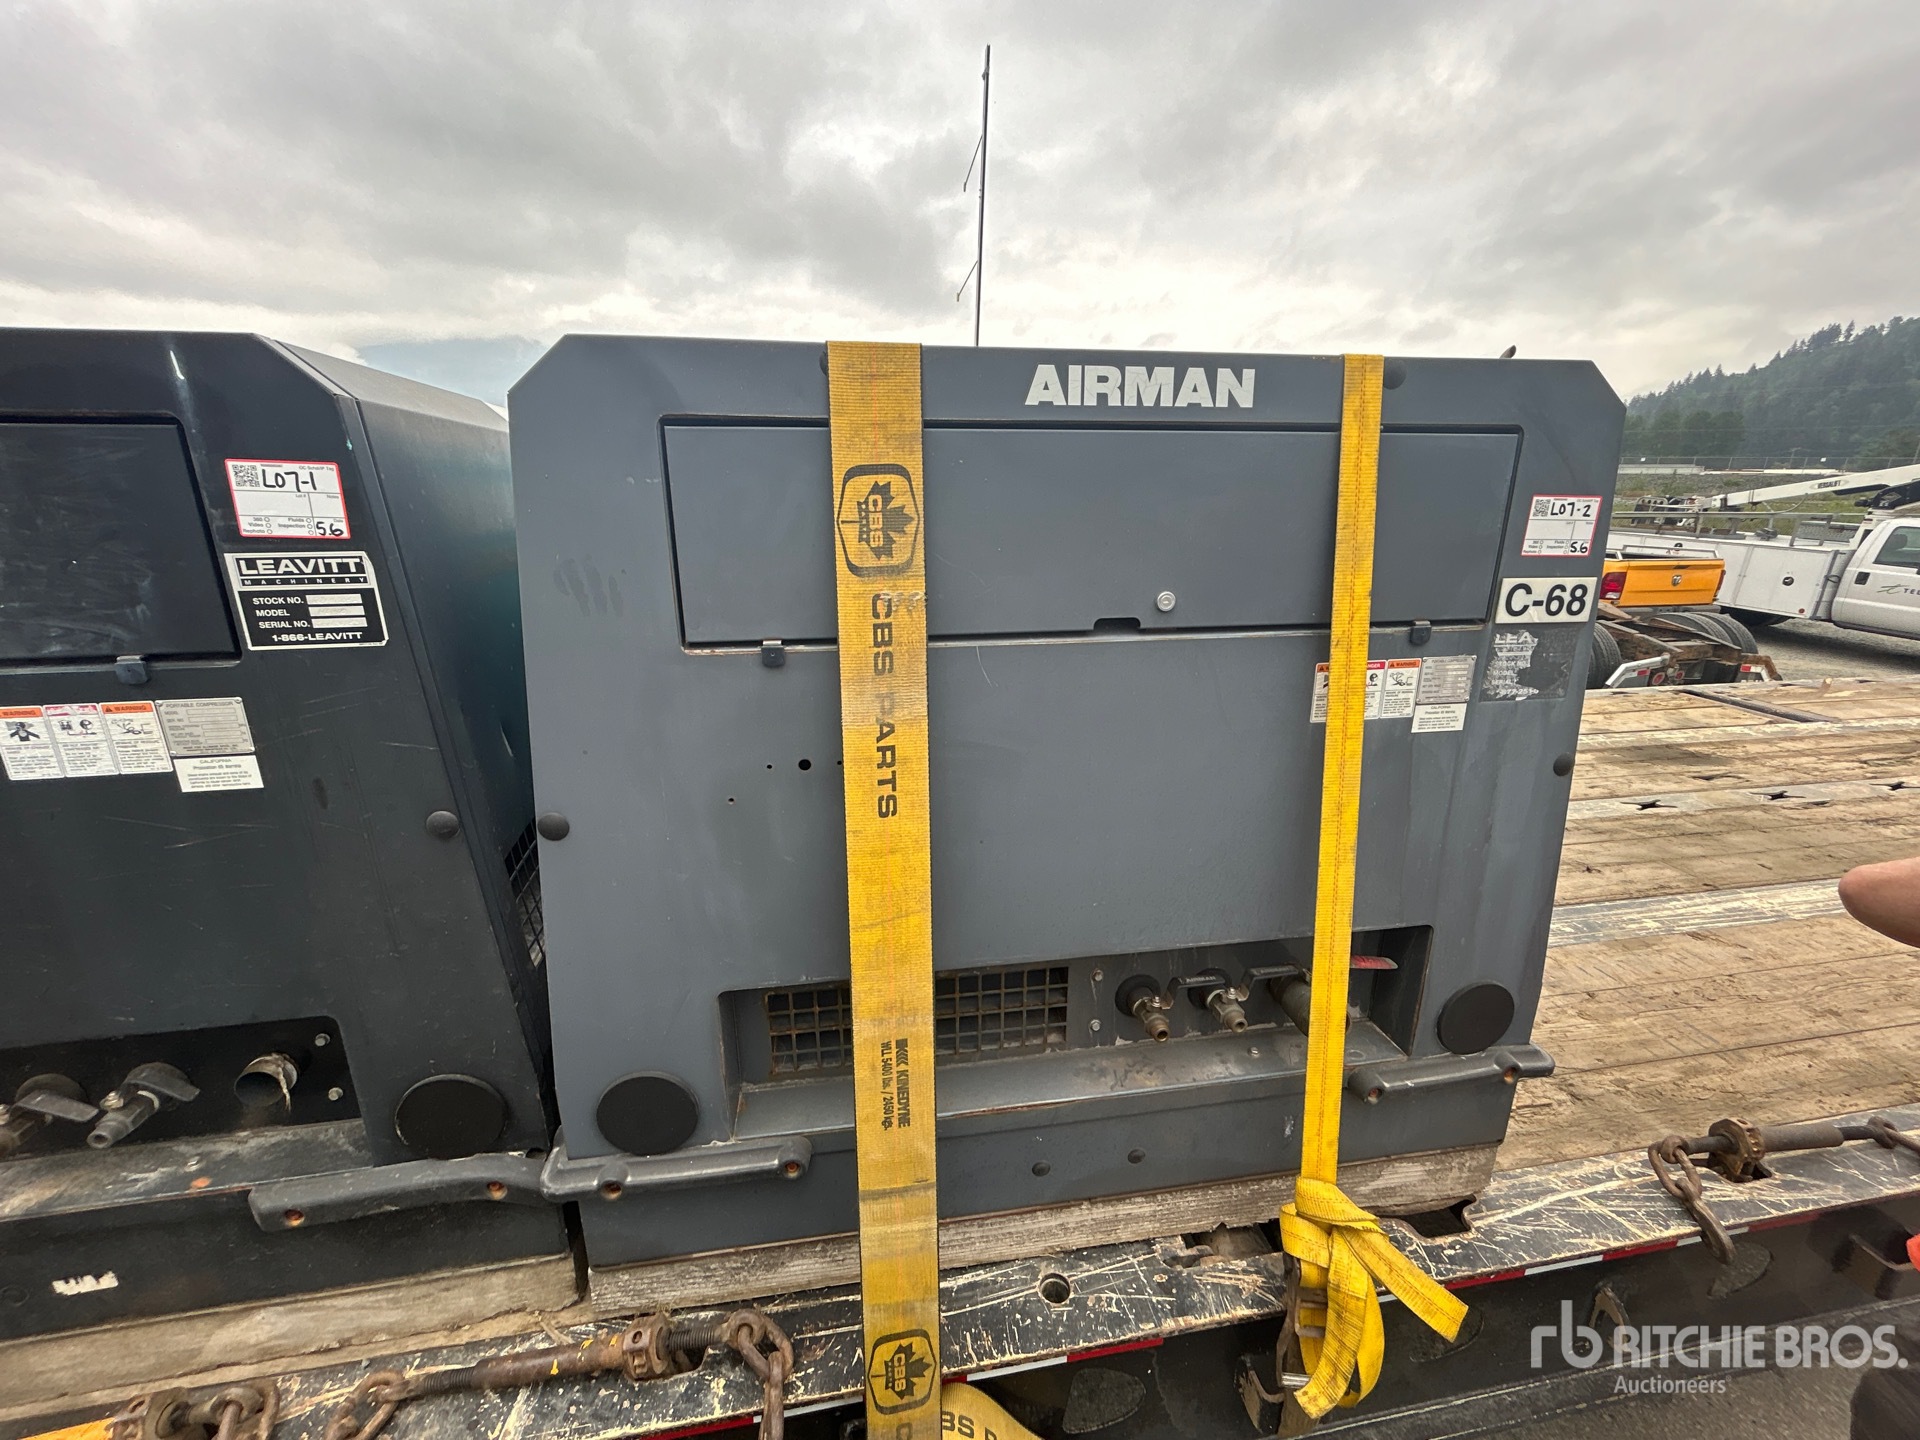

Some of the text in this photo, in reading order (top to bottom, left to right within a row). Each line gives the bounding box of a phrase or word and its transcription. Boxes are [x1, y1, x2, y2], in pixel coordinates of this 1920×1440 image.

[1024, 364, 1256, 408] AIRMAN
[868, 494, 883, 547] CBS
[238, 558, 361, 574] LEAVITT
[1505, 583, 1588, 616] C-68
[272, 632, 362, 641] 1-866-LEAVITT
[872, 593, 897, 818] CBS PARTS
[881, 1041, 892, 1057] WLL
[882, 1058, 892, 1076] 5400
[896, 1070, 910, 1128] KINEDYNE
[894, 1354, 906, 1392] CBS
